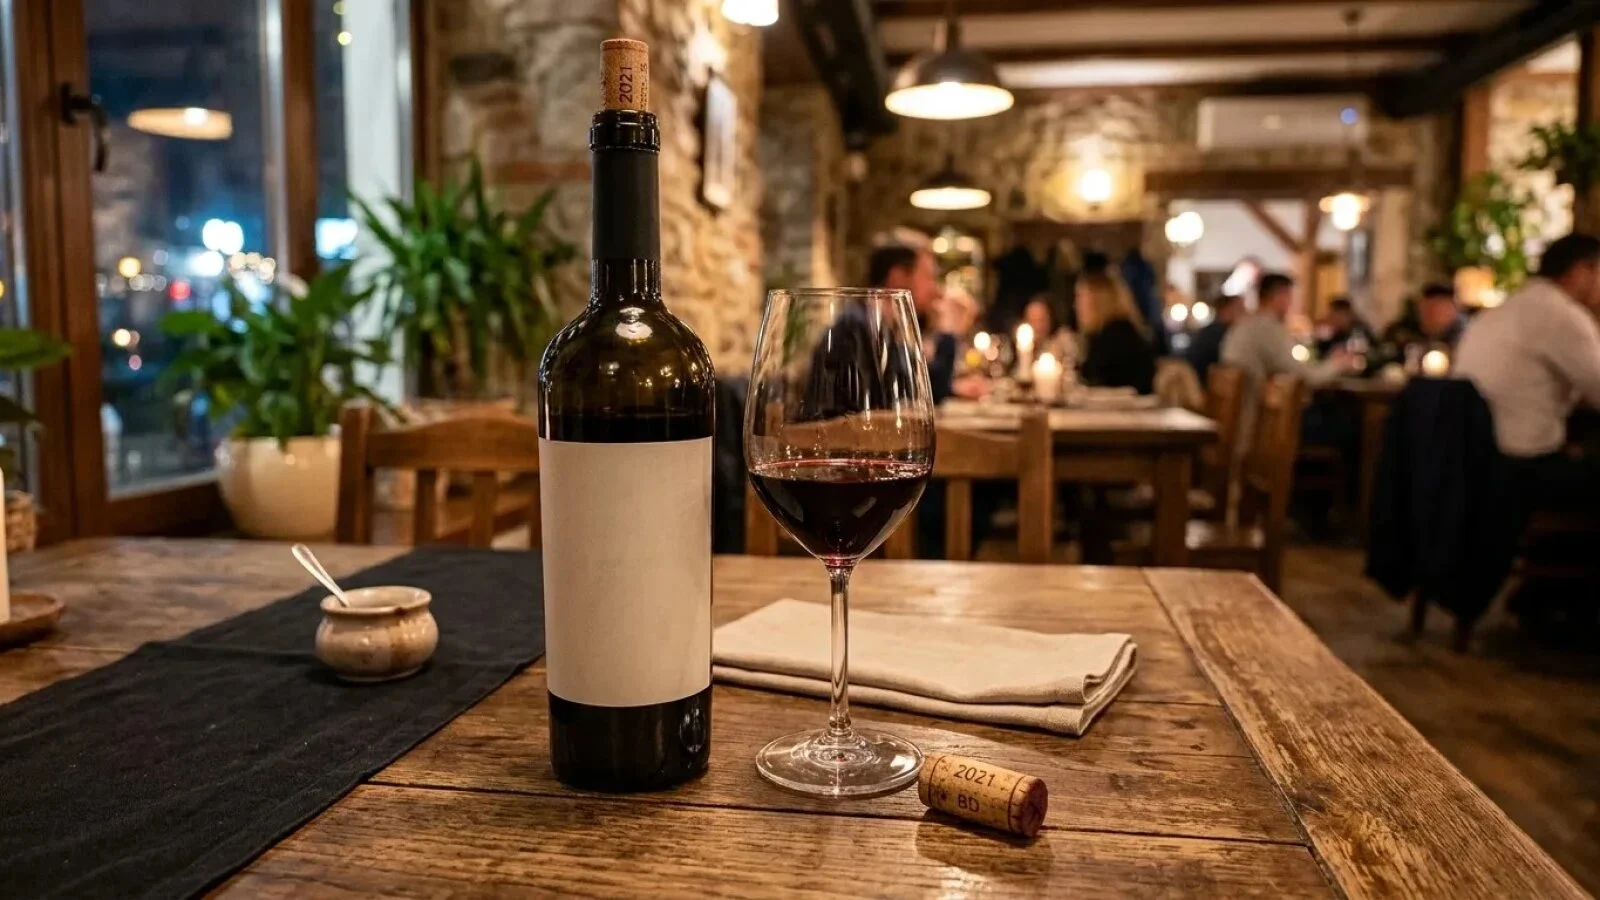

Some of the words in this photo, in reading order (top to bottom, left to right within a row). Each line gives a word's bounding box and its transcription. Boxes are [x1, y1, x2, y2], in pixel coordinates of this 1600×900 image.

[619, 66, 633, 104] 2021
[953, 764, 996, 787] 2021
[958, 794, 980, 813] BD
